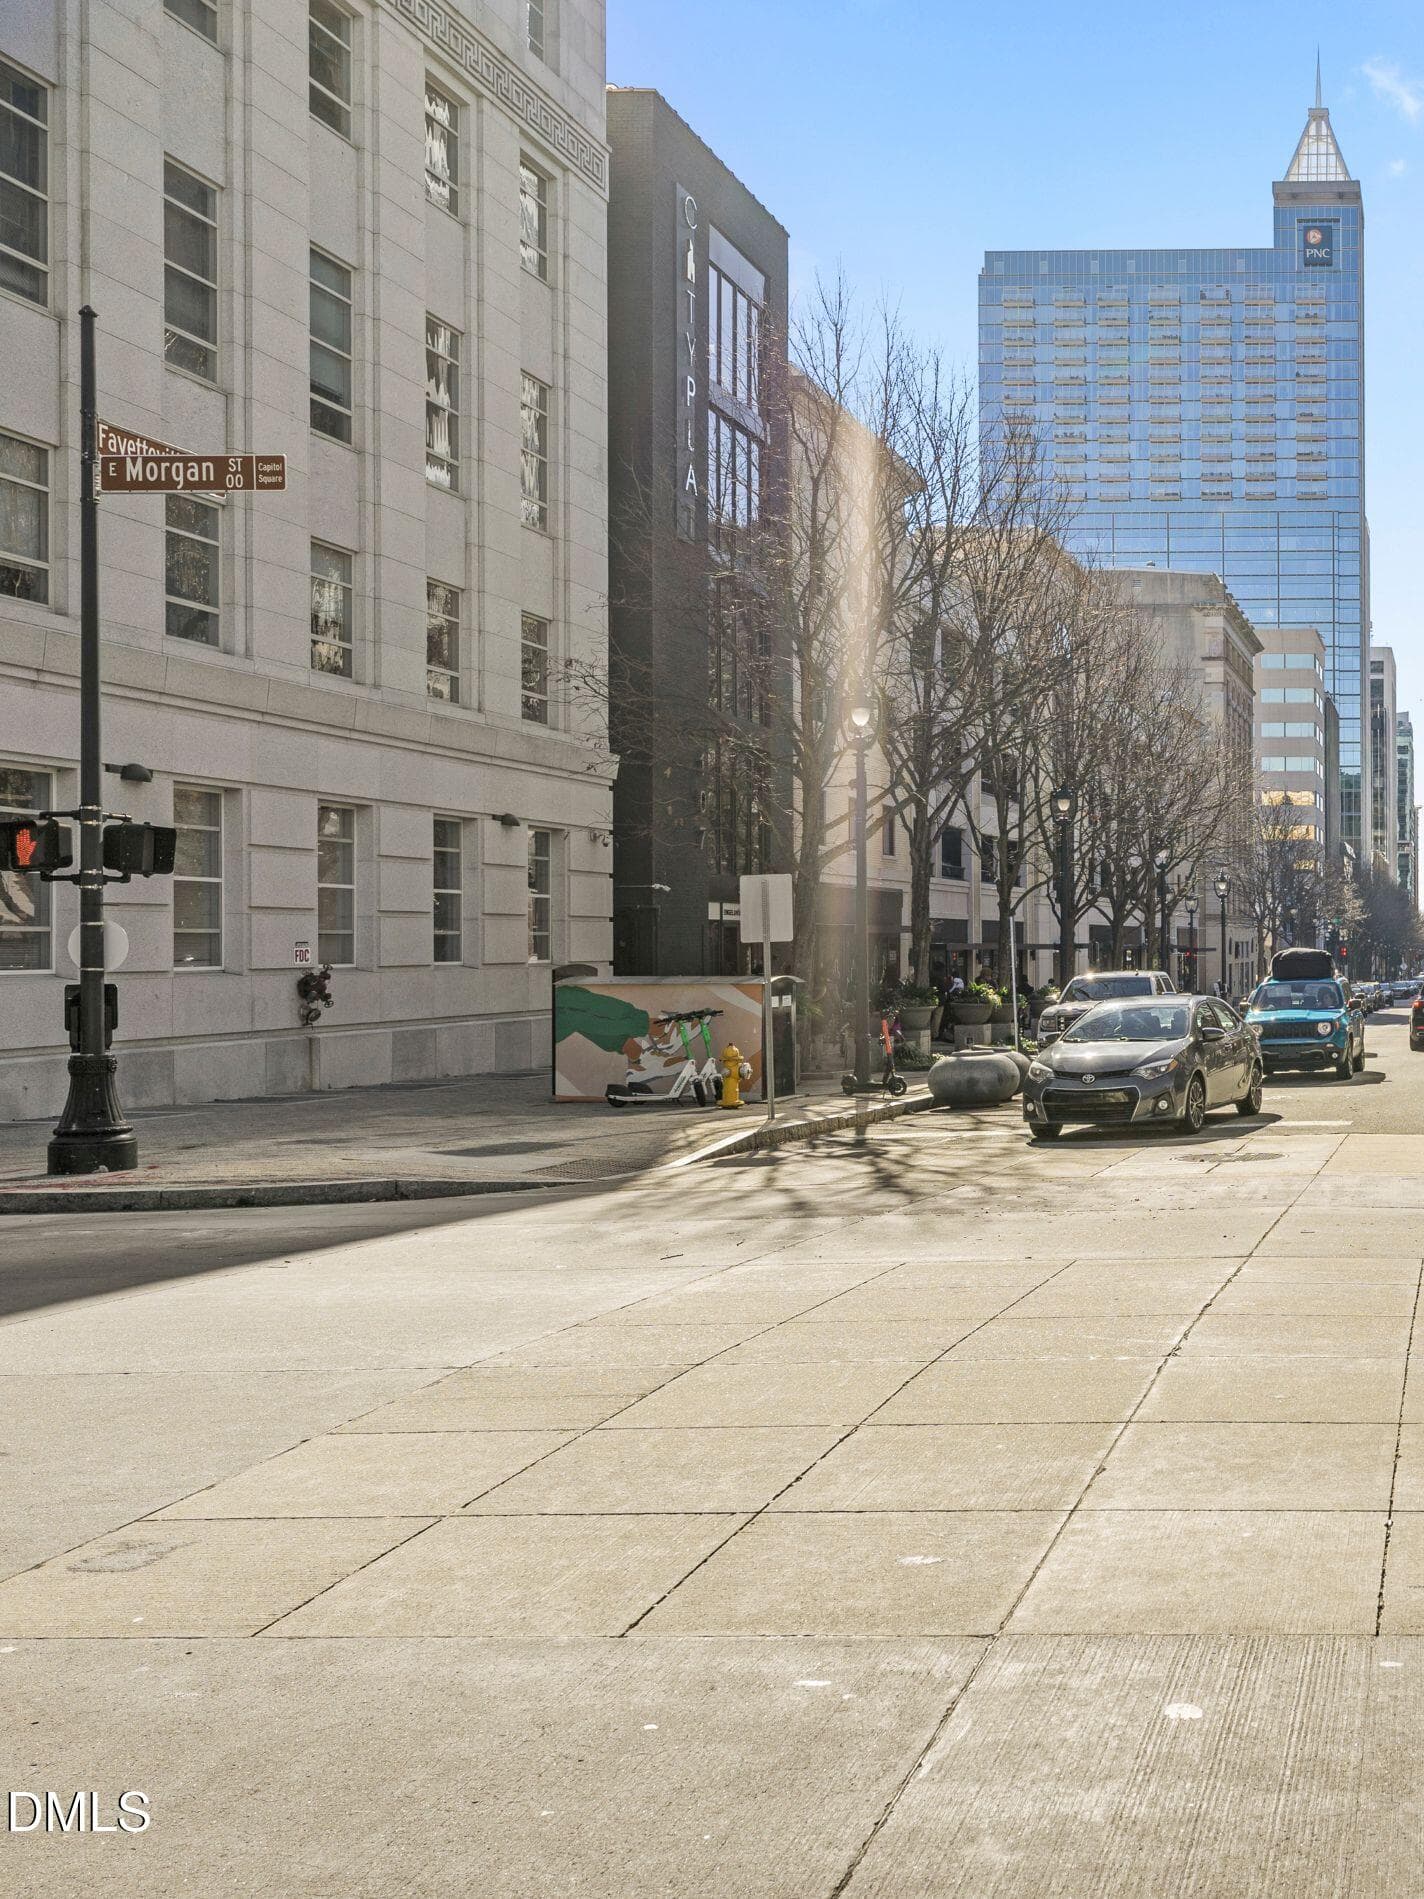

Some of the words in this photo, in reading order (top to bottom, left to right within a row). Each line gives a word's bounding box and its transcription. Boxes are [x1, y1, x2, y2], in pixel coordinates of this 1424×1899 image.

[1306, 248, 1331, 258] PNC
[258, 462, 283, 473] Capitol
[109, 462, 117, 476] E
[126, 457, 214, 490] Morgan
[228, 458, 243, 472] ST
[258, 474, 283, 484] Square
[295, 949, 310, 962] FDC
